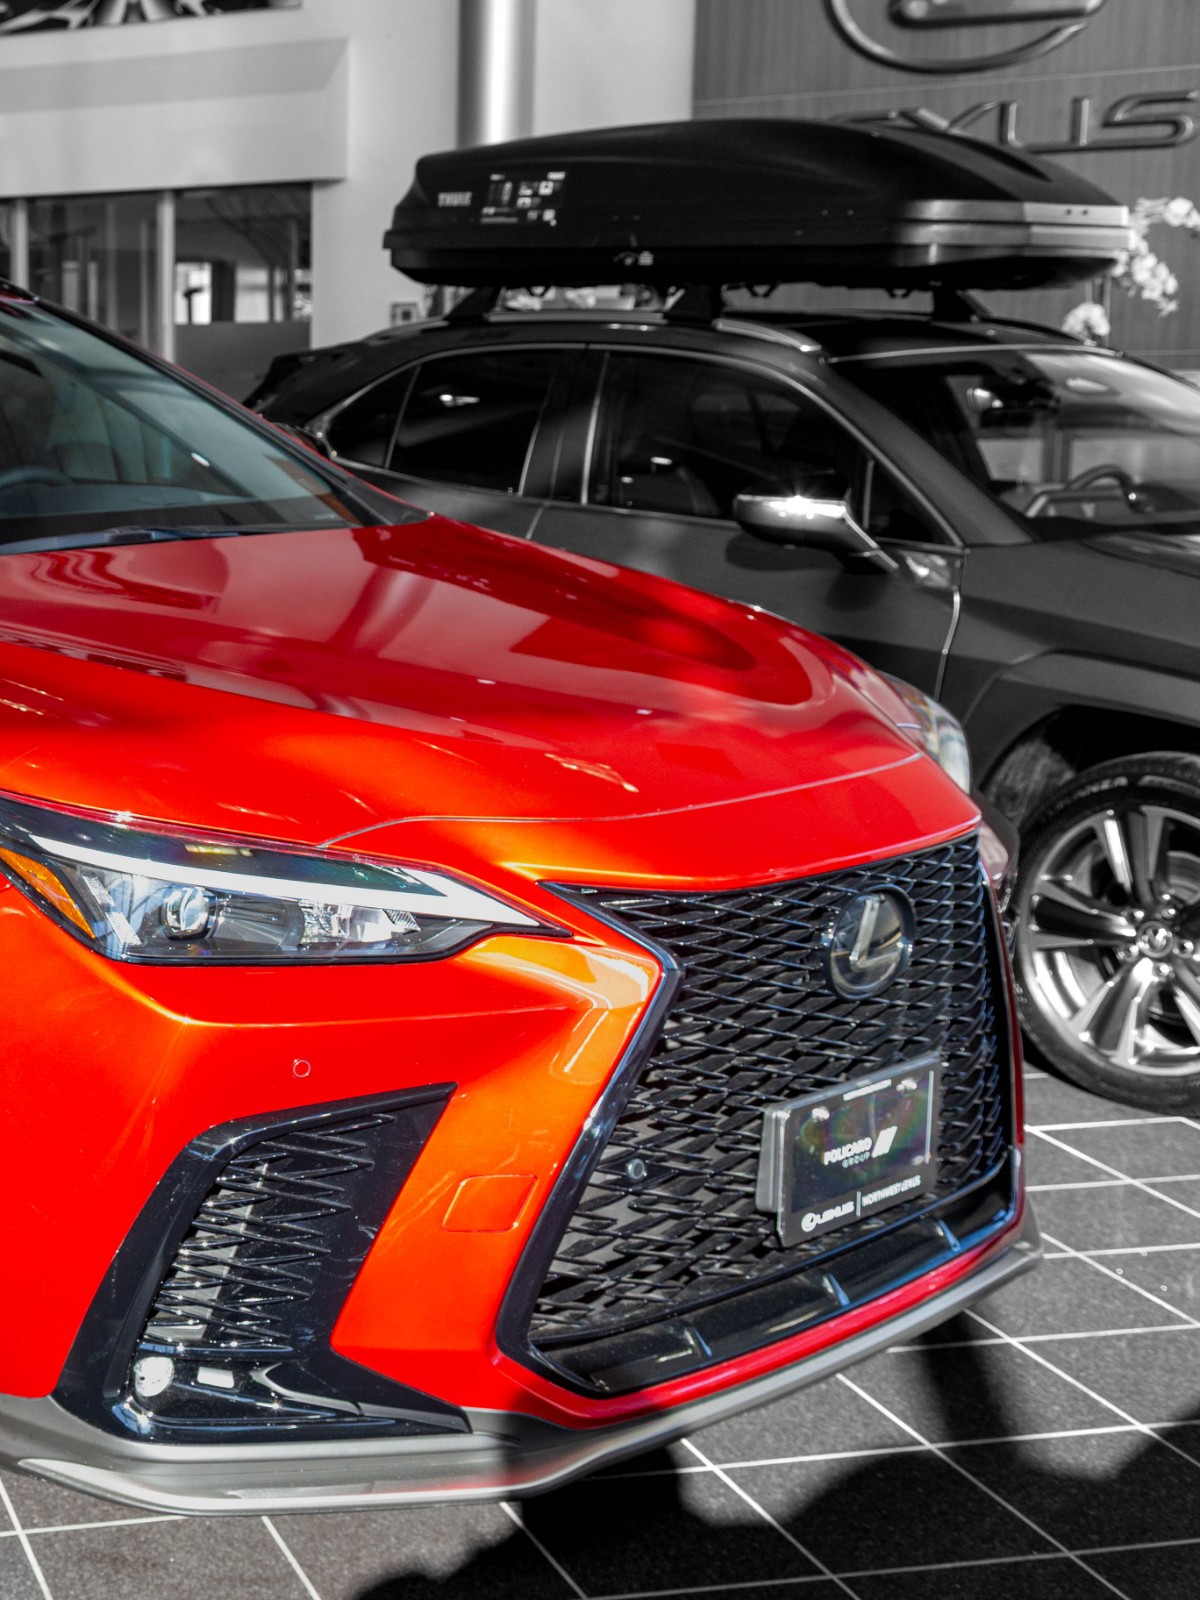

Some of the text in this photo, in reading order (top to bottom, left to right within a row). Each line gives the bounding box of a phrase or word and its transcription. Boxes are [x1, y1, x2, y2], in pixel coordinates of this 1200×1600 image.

[830, 90, 1199, 154] XUS
[824, 1137, 872, 1165] POLICARO
[842, 1152, 870, 1168] GROUP
